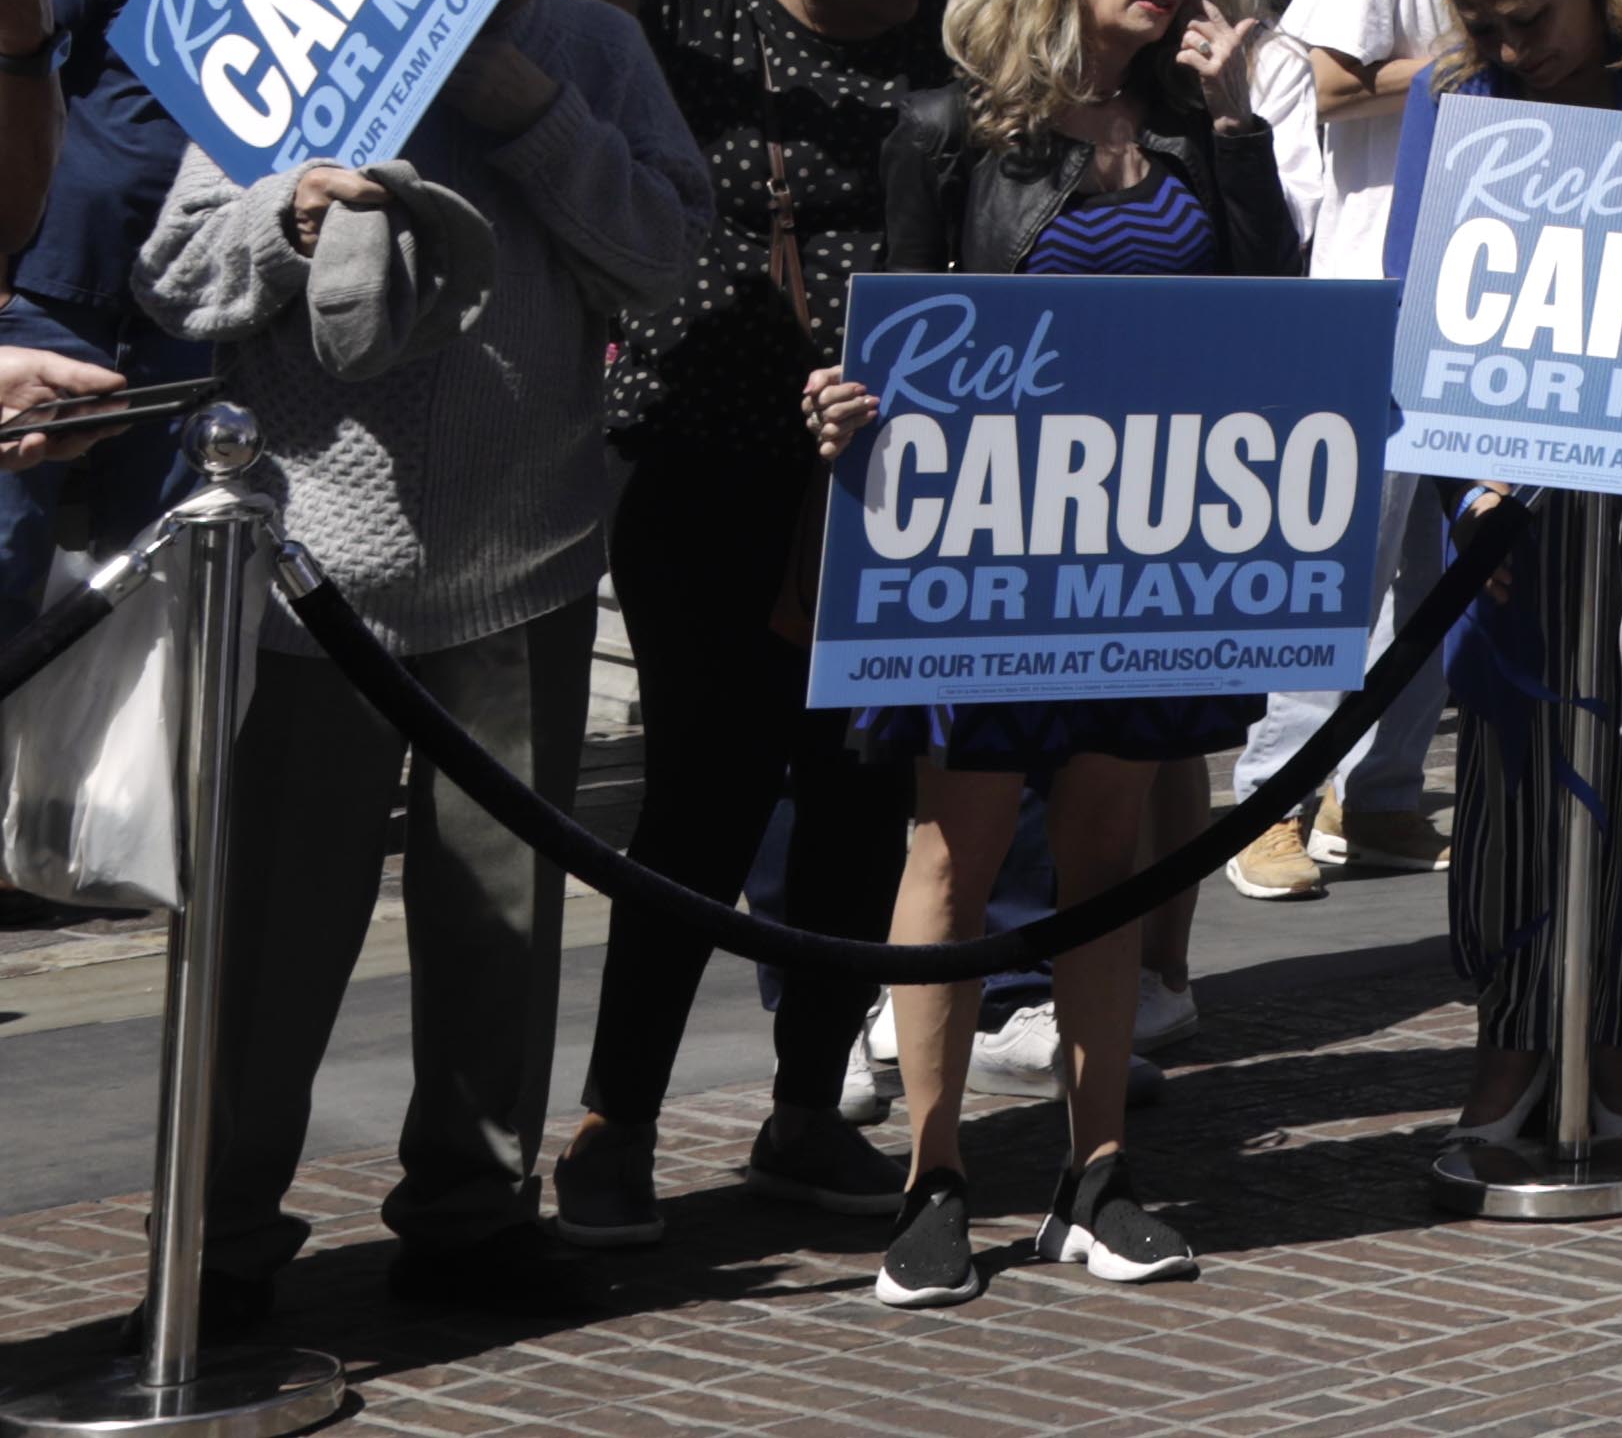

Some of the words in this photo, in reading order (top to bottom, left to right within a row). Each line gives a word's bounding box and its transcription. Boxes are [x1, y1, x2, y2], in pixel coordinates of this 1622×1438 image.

[861, 294, 1066, 419] Rick
[862, 412, 1358, 557] CARUSO
[855, 564, 1028, 623] FOR
[1052, 559, 1344, 618] MAYOR
[848, 655, 913, 683] JOIN
[918, 654, 974, 678] OUR
[981, 651, 1055, 677] TEAM
[1061, 650, 1095, 674] AT
